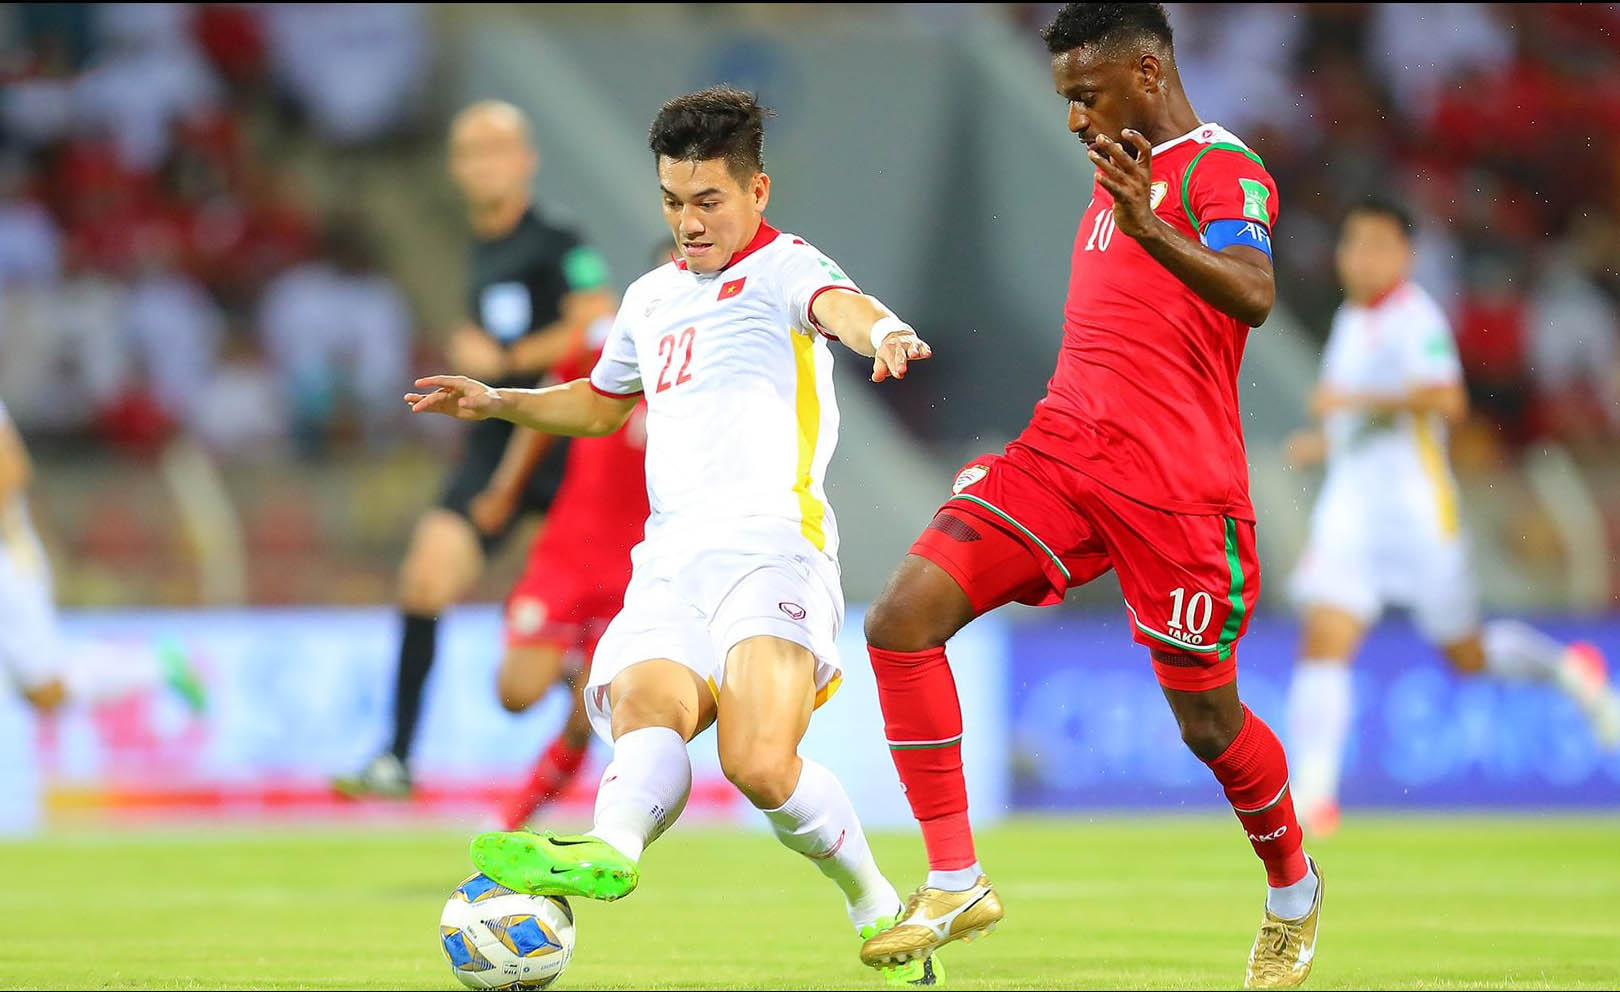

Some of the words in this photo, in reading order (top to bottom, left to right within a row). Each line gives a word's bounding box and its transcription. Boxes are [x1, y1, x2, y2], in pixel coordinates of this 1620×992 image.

[1084, 208, 1116, 251] 10
[655, 327, 696, 394] 22
[1167, 587, 1213, 635] 10
[1244, 825, 1287, 842] AKO
